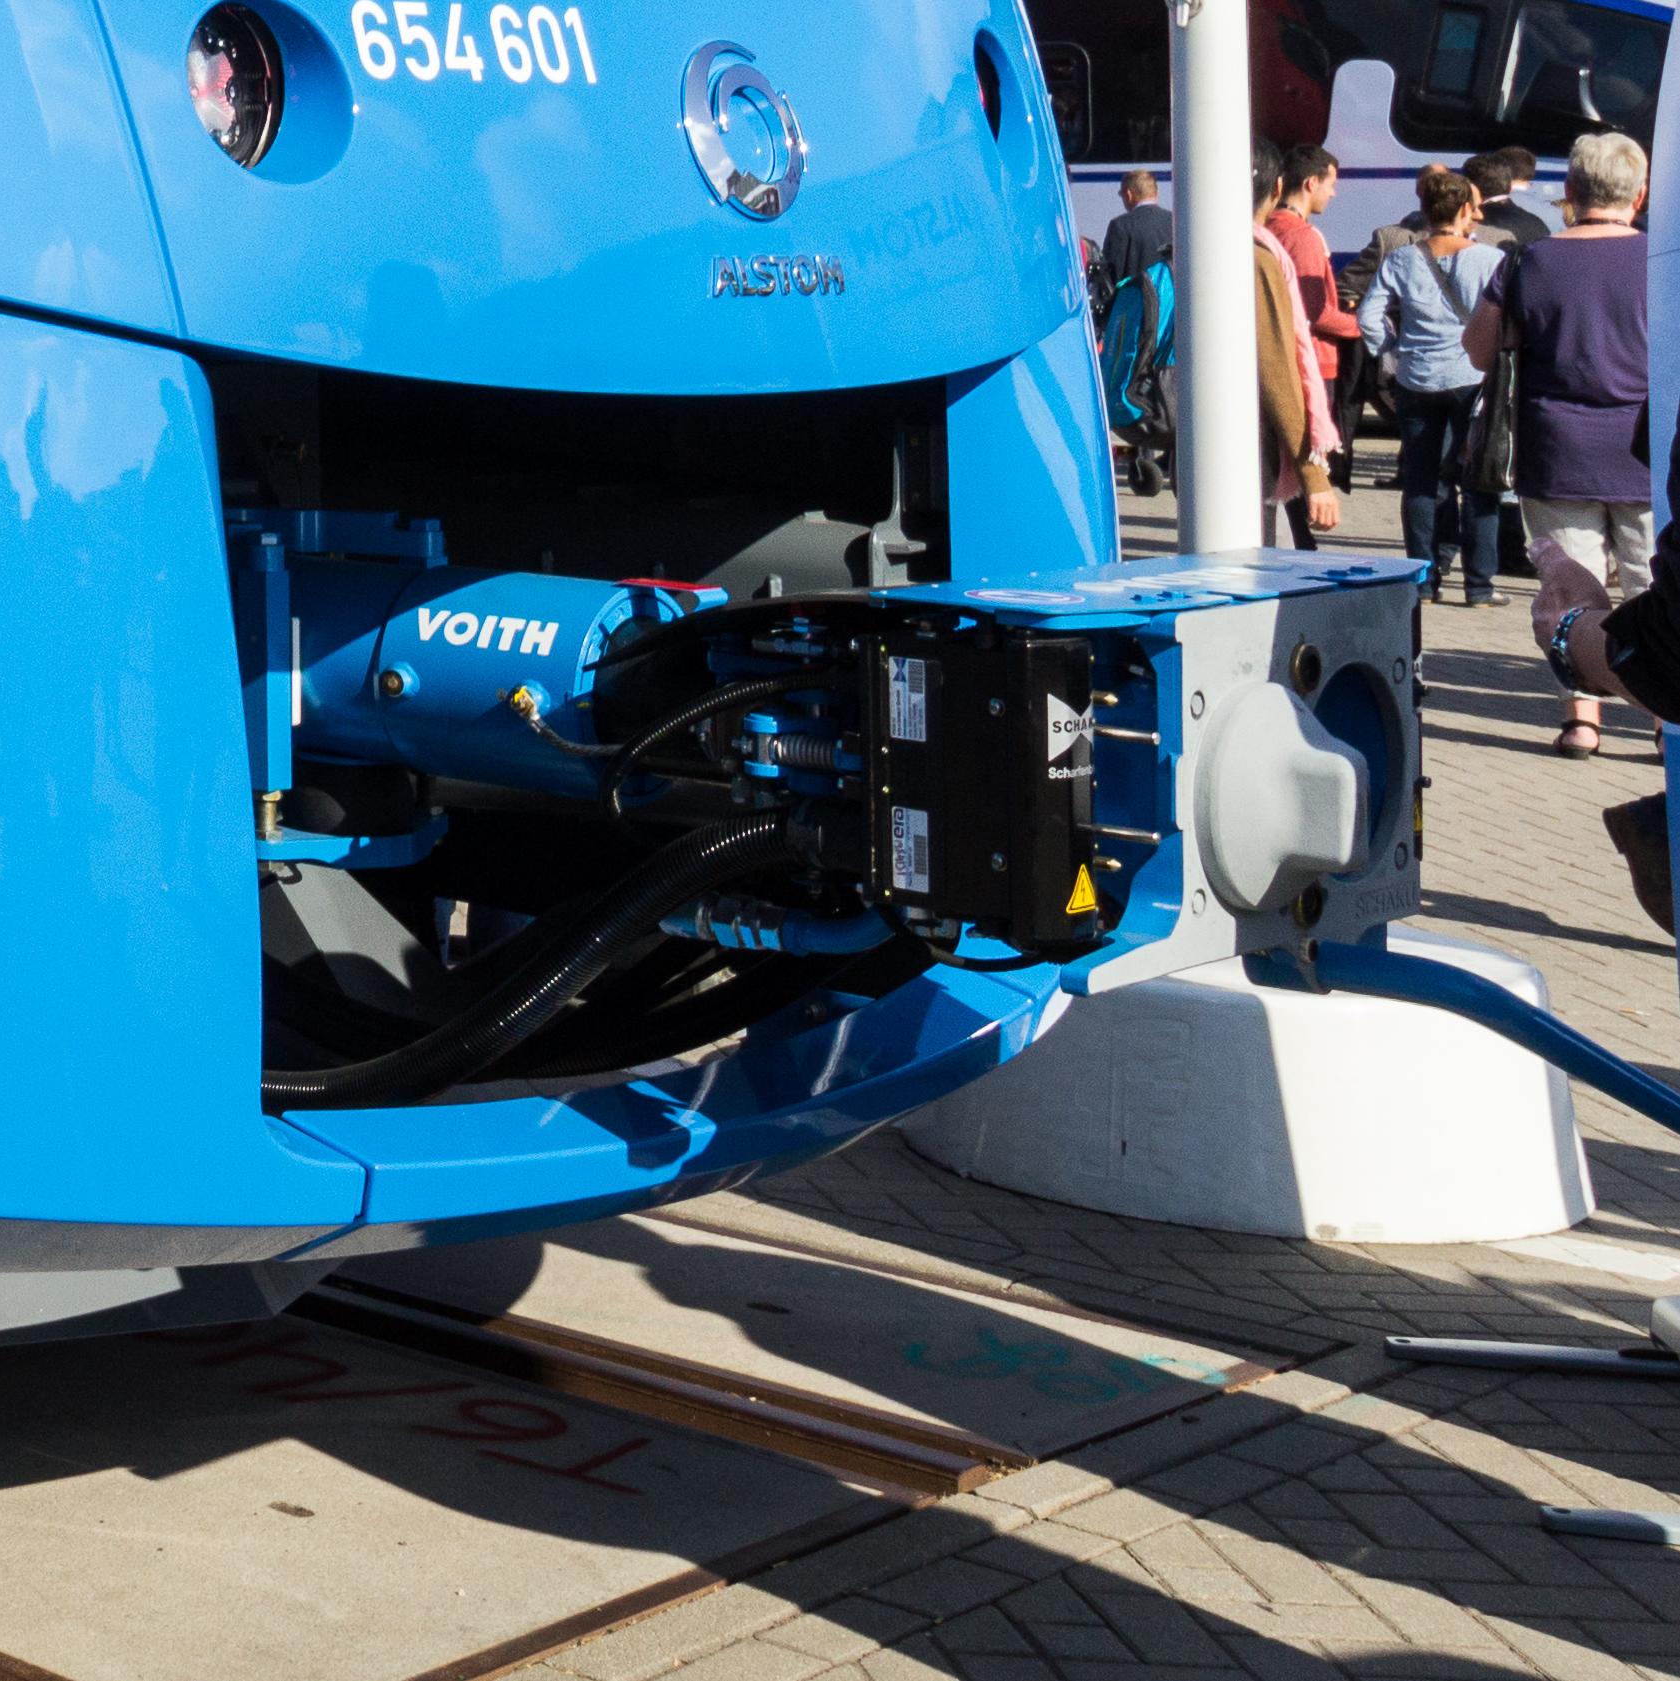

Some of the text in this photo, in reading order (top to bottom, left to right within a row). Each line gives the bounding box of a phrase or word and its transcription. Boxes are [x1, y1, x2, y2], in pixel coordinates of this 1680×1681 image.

[489, 4, 597, 83] 601
[712, 254, 846, 297] ALSTOM
[418, 607, 560, 657] VOITH
